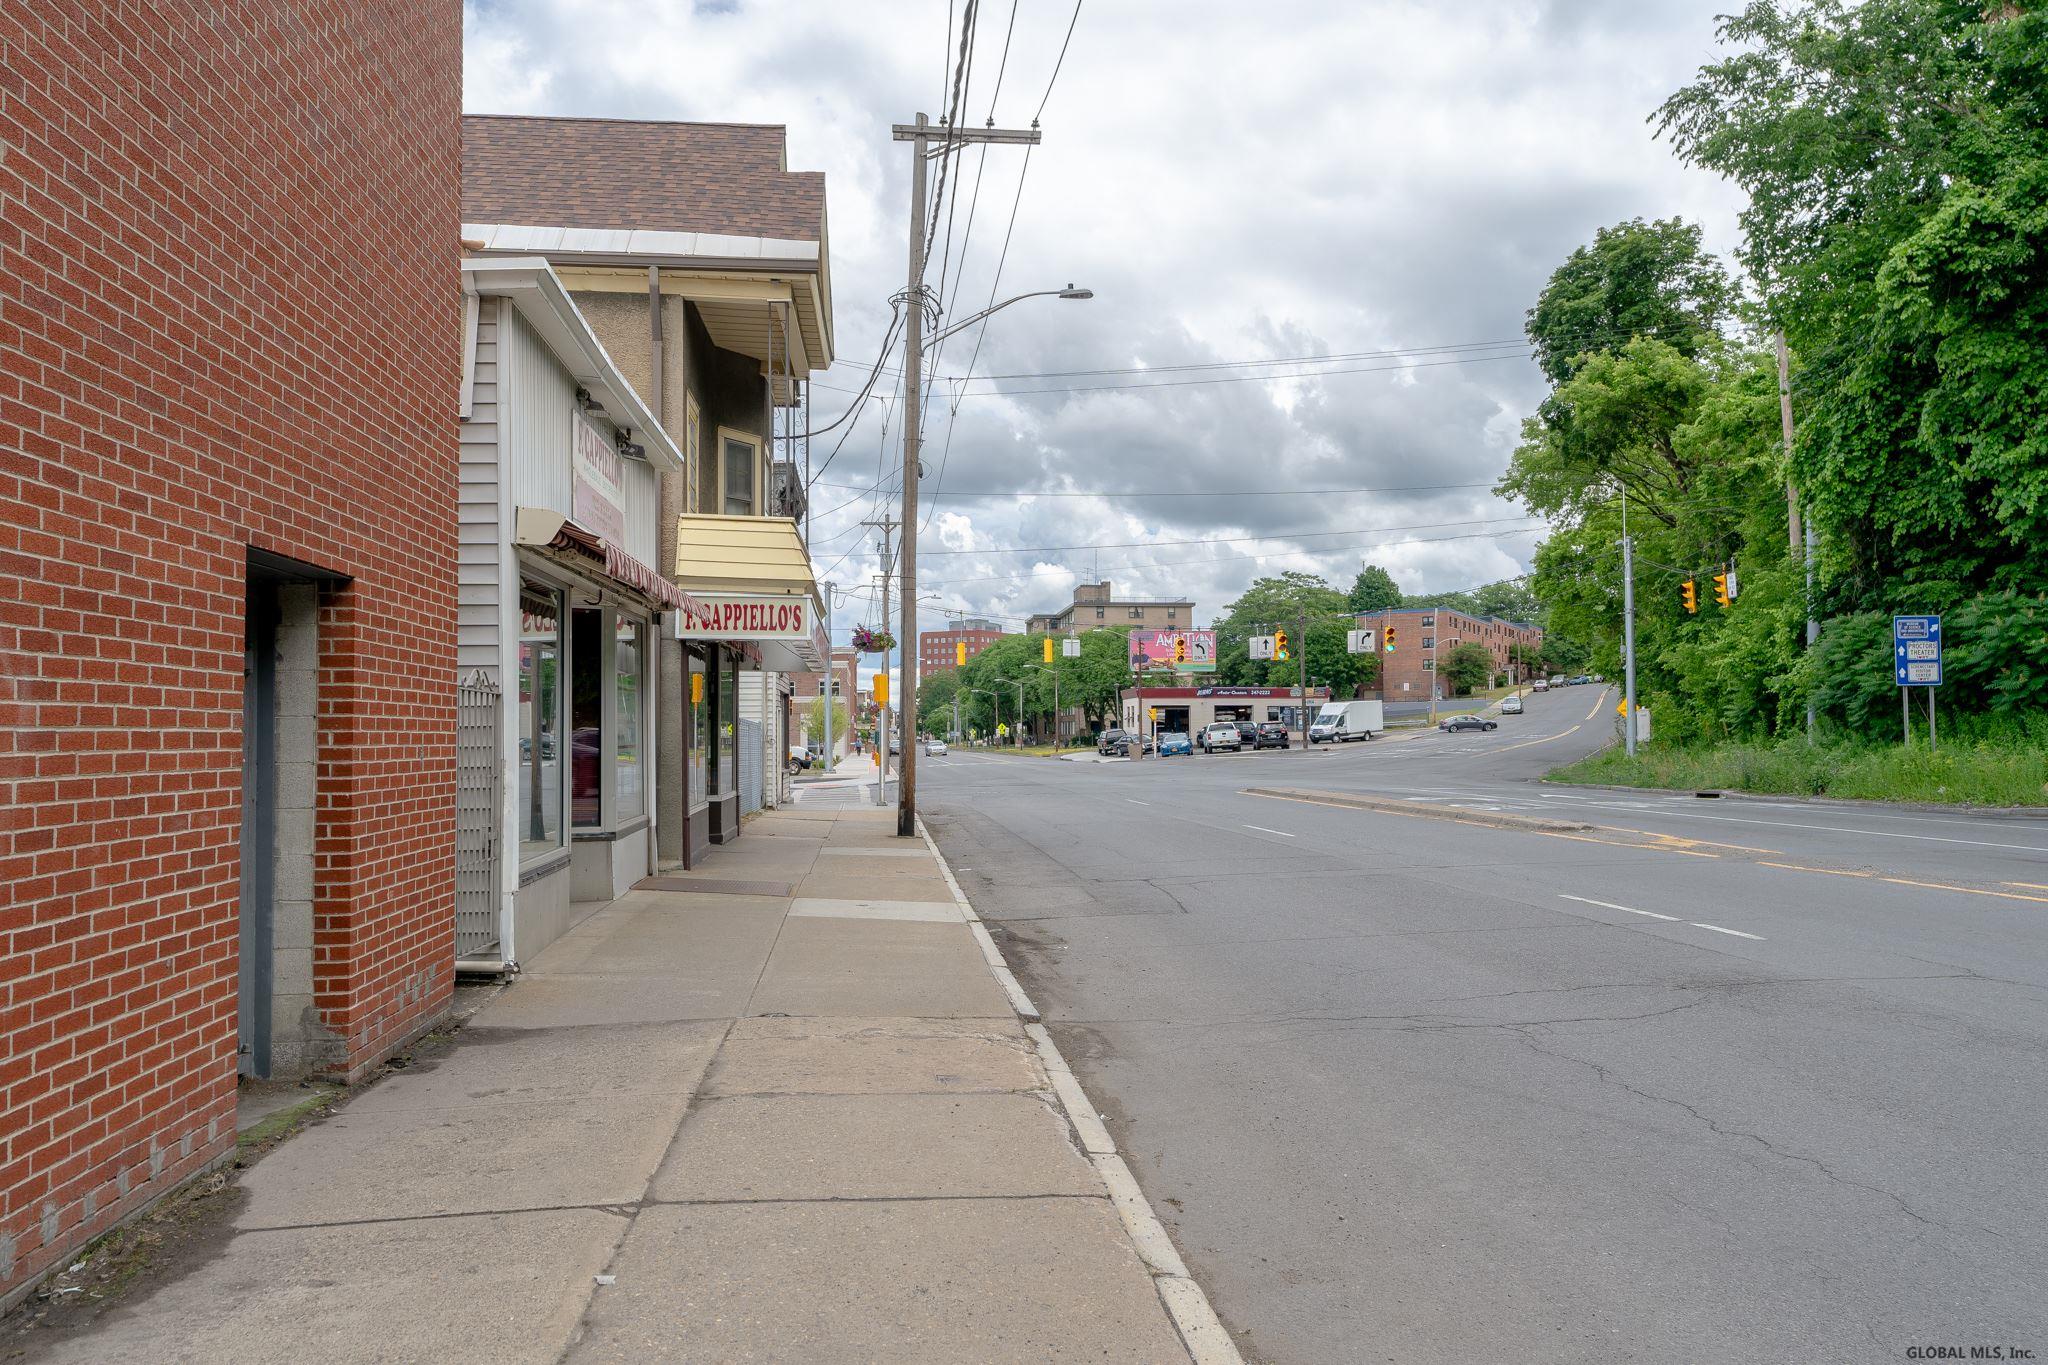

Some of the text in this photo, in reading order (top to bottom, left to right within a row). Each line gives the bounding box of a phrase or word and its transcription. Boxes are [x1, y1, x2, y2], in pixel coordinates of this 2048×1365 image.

[584, 424, 623, 492] CAPPIELLO
[702, 603, 802, 632] CAPPIELLO'S
[1156, 632, 1213, 648] AMTION
